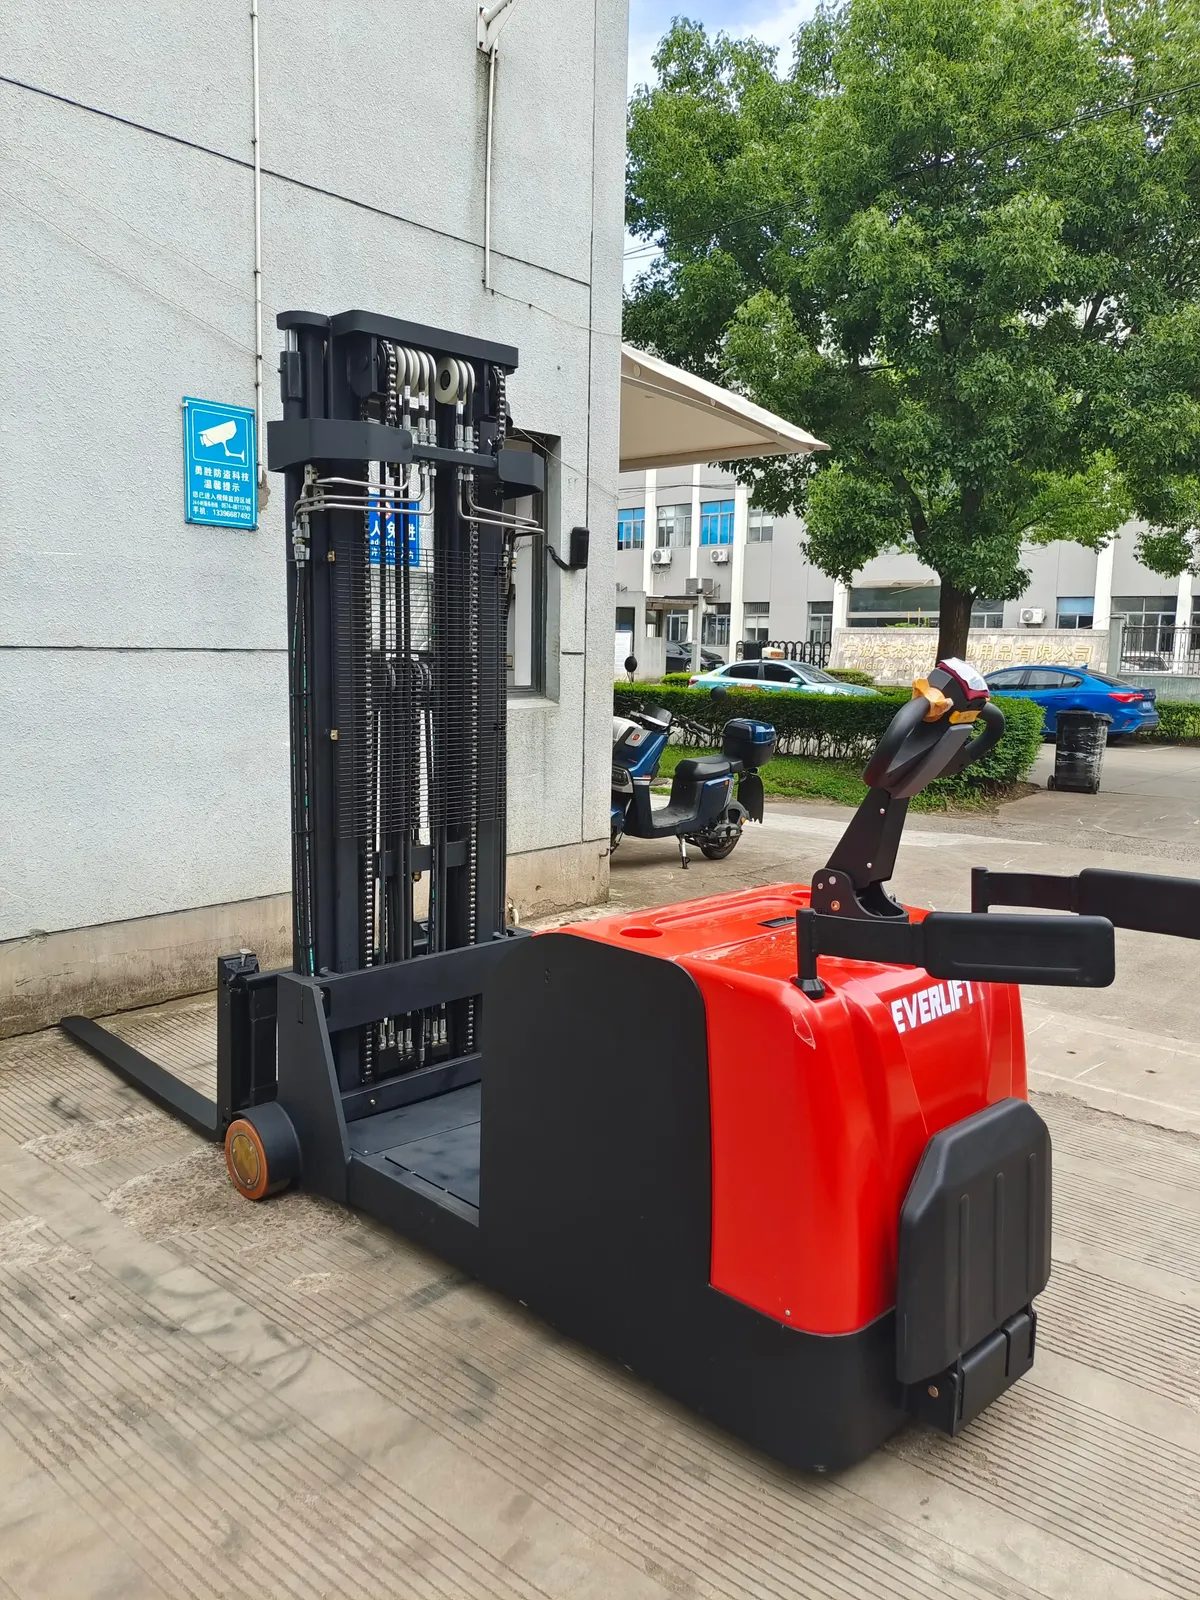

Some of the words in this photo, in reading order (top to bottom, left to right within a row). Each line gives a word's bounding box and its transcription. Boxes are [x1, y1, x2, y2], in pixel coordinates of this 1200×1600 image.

[203, 479, 240, 493] 温馨提示
[192, 491, 251, 505] 您已进入视频监控区域
[843, 642, 1094, 664] 宁波英杰沃特地用品有限公司
[890, 980, 973, 1034] EVERLIFT
